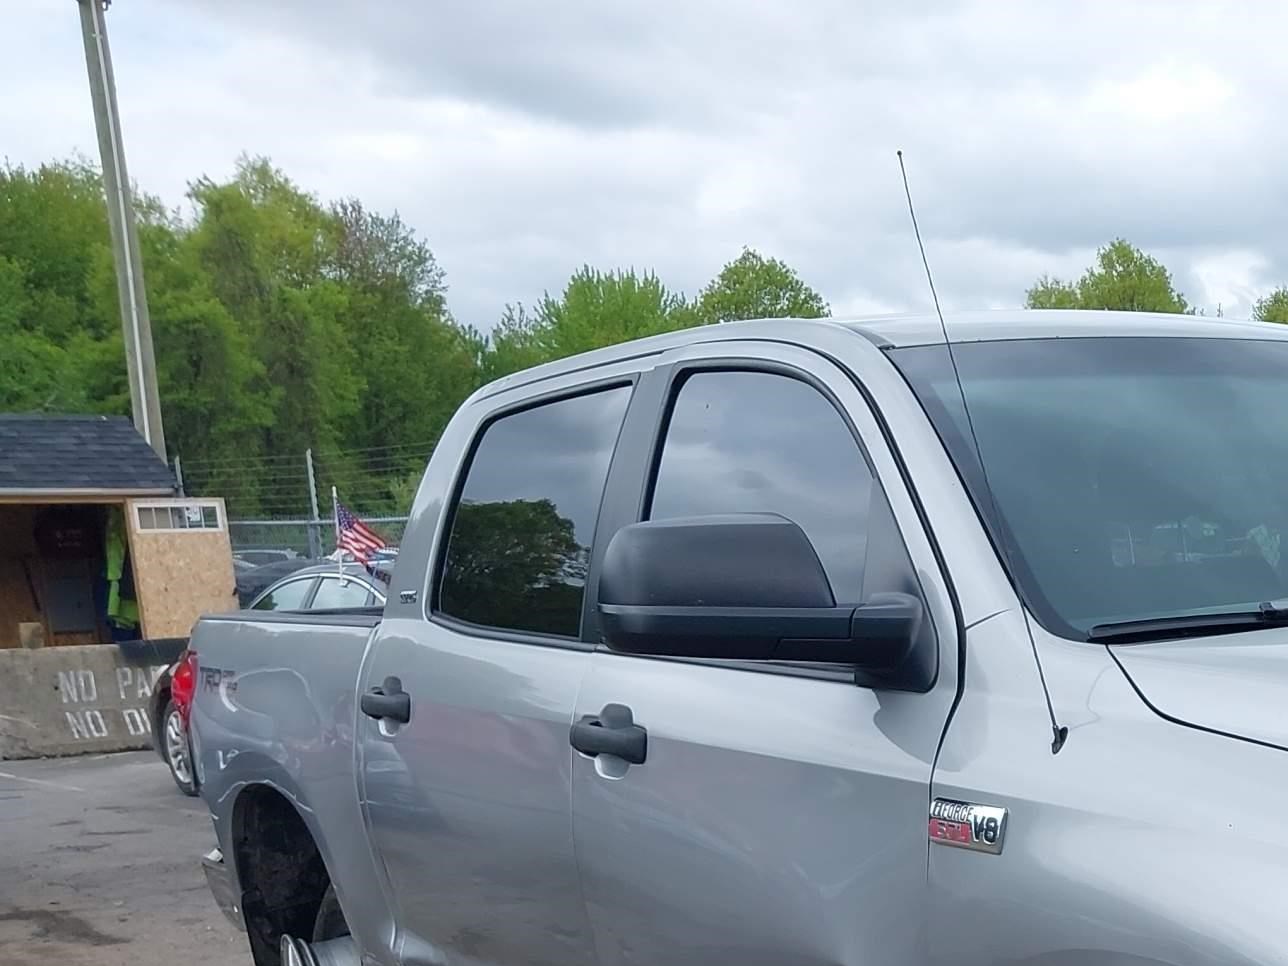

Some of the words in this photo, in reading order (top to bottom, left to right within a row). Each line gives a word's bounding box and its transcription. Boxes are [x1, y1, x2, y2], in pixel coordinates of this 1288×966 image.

[59, 670, 97, 703] NO
[65, 710, 108, 739] NO
[973, 814, 999, 844] V8
